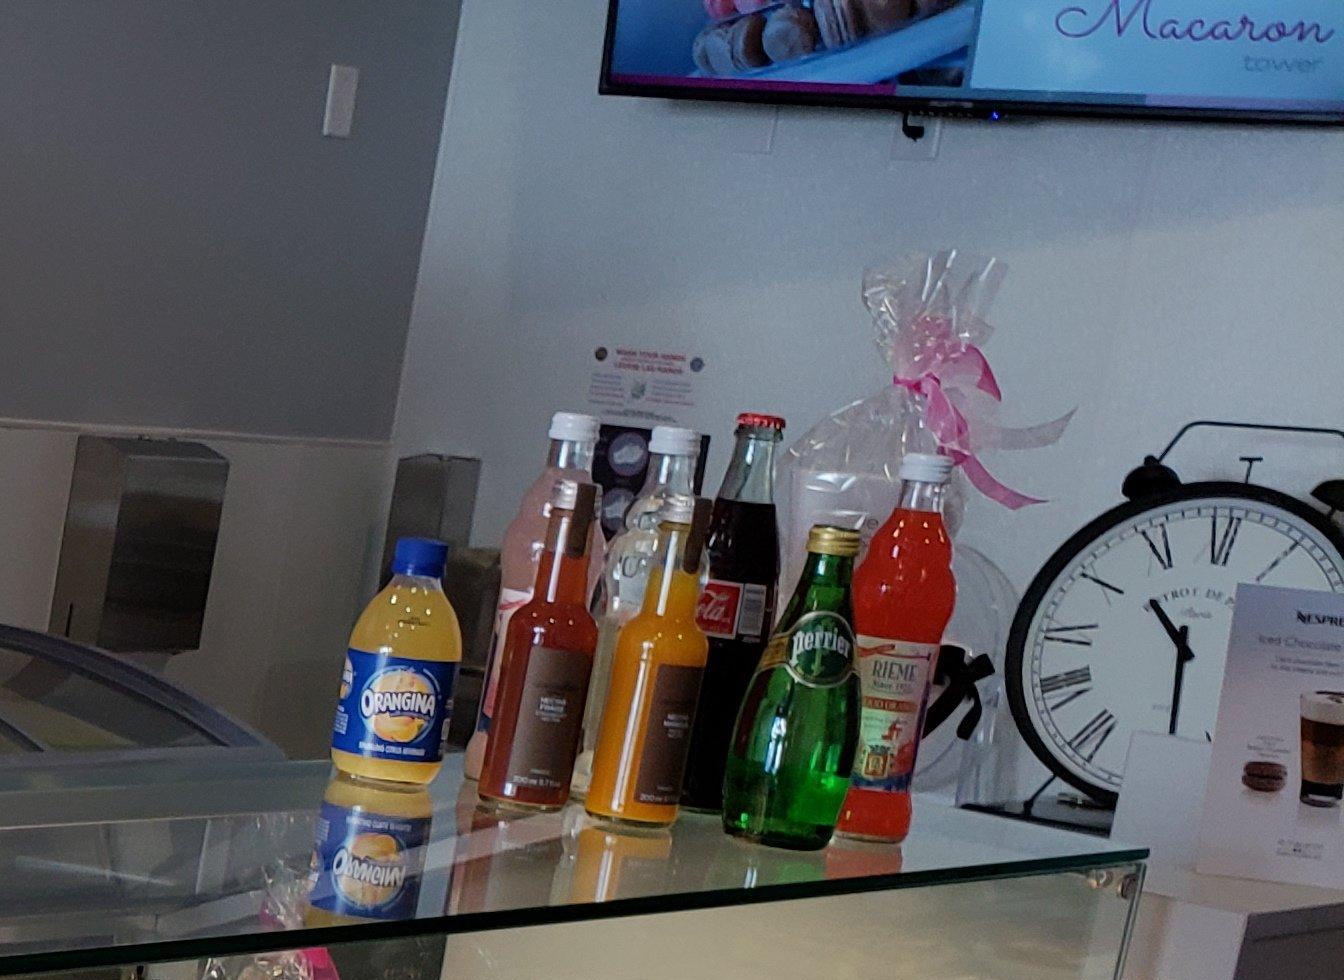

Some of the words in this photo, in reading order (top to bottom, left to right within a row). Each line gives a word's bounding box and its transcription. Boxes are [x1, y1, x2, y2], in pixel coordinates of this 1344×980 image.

[1055, 0, 1335, 43] Macaron
[1242, 54, 1326, 73] tower
[1296, 609, 1344, 628] NESPRE
[362, 688, 436, 717] ORANGINA
